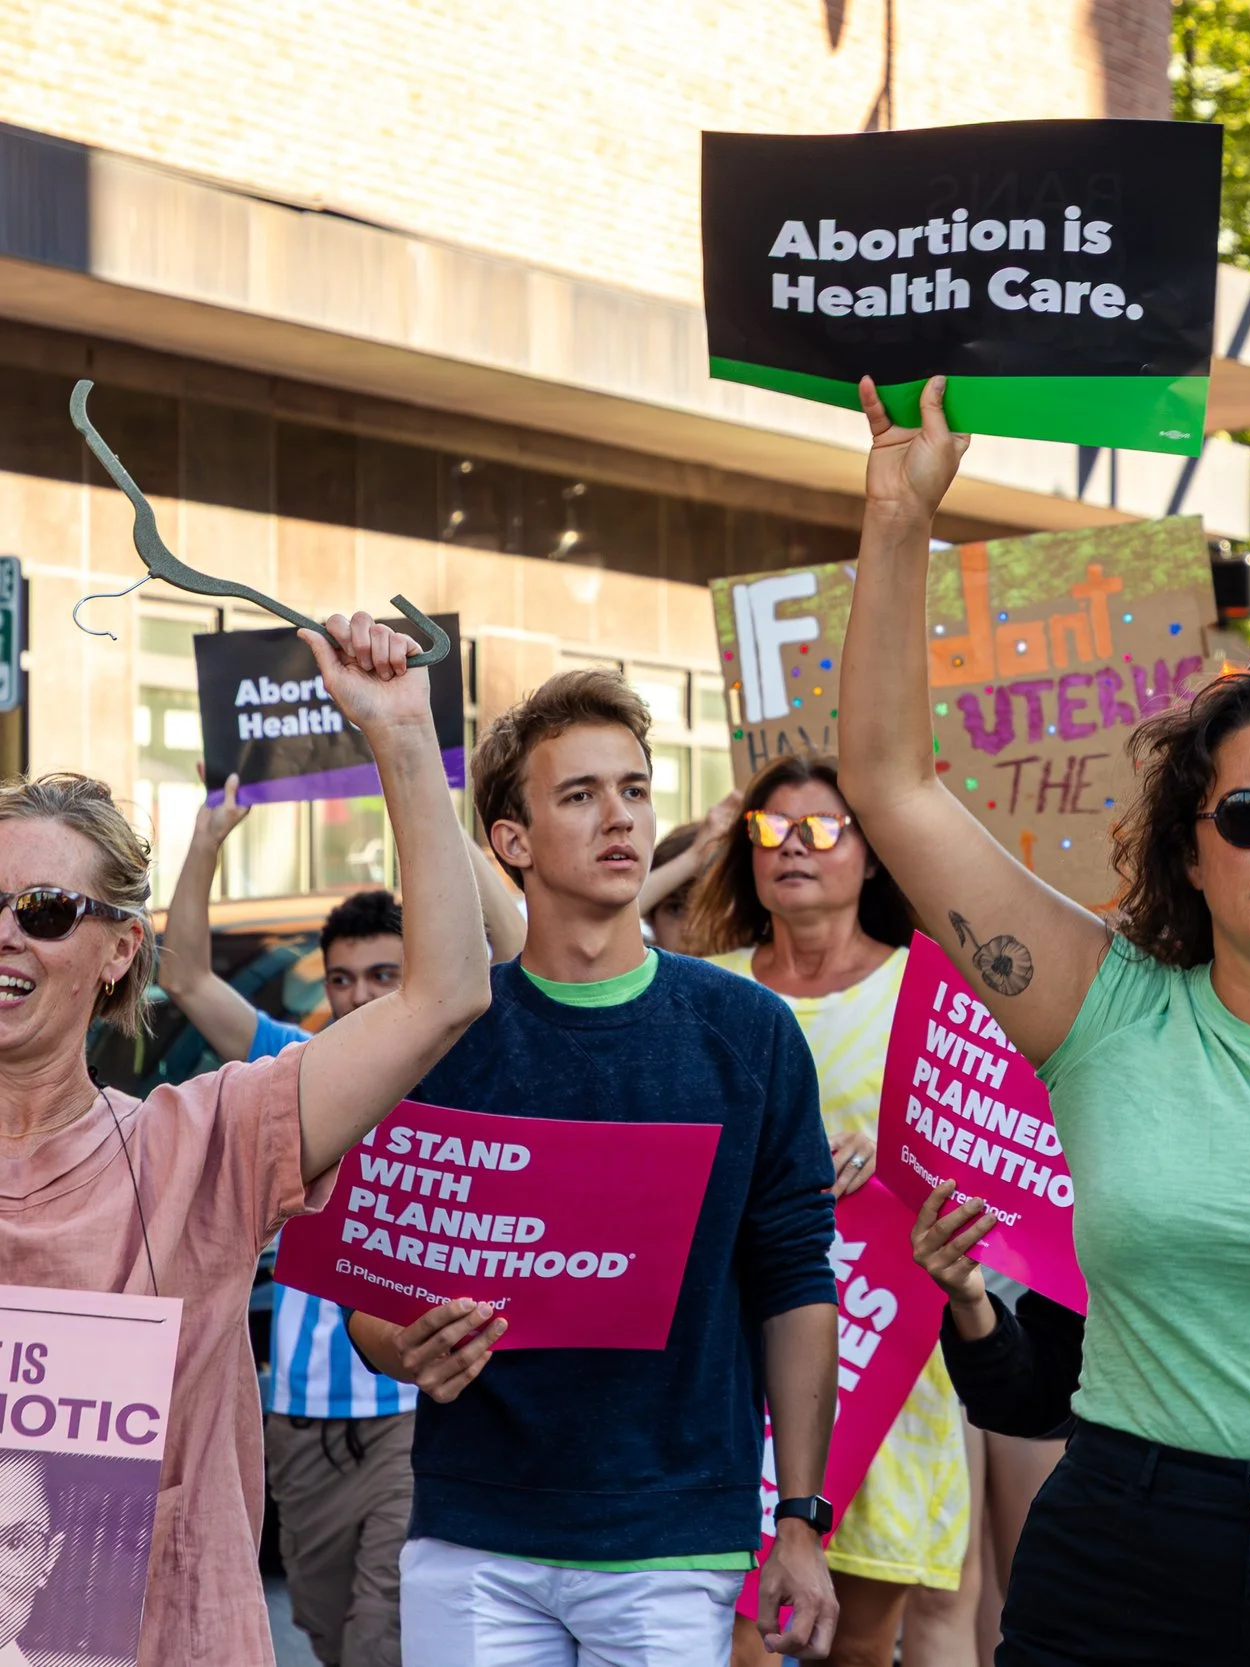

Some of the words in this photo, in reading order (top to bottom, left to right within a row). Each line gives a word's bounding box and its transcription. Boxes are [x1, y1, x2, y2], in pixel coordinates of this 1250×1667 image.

[769, 208, 1045, 262] Abortion
[1064, 206, 1113, 255] is
[772, 269, 970, 319] Health
[987, 267, 1144, 321] Care.
[733, 572, 820, 723] IF
[234, 676, 329, 707] Abort
[238, 705, 342, 740] Health
[746, 724, 830, 773] HAV
[995, 754, 1110, 816] THE
[931, 981, 948, 1012] I
[947, 992, 1018, 1052] STA
[926, 1019, 1009, 1090] WITH
[912, 1057, 1063, 1158] PLANNED
[386, 1126, 531, 1172] STAND
[905, 1095, 1075, 1208] PARENTHO
[359, 1153, 471, 1203] WITH
[908, 1153, 939, 1189] Planned
[939, 1179, 1017, 1227] rehood
[348, 1186, 545, 1244] PLANNED
[341, 1218, 629, 1279] PARENTHOOD
[353, 1265, 414, 1297] Planned
[415, 1287, 507, 1311] Pareod
[10, 1342, 48, 1385] IS
